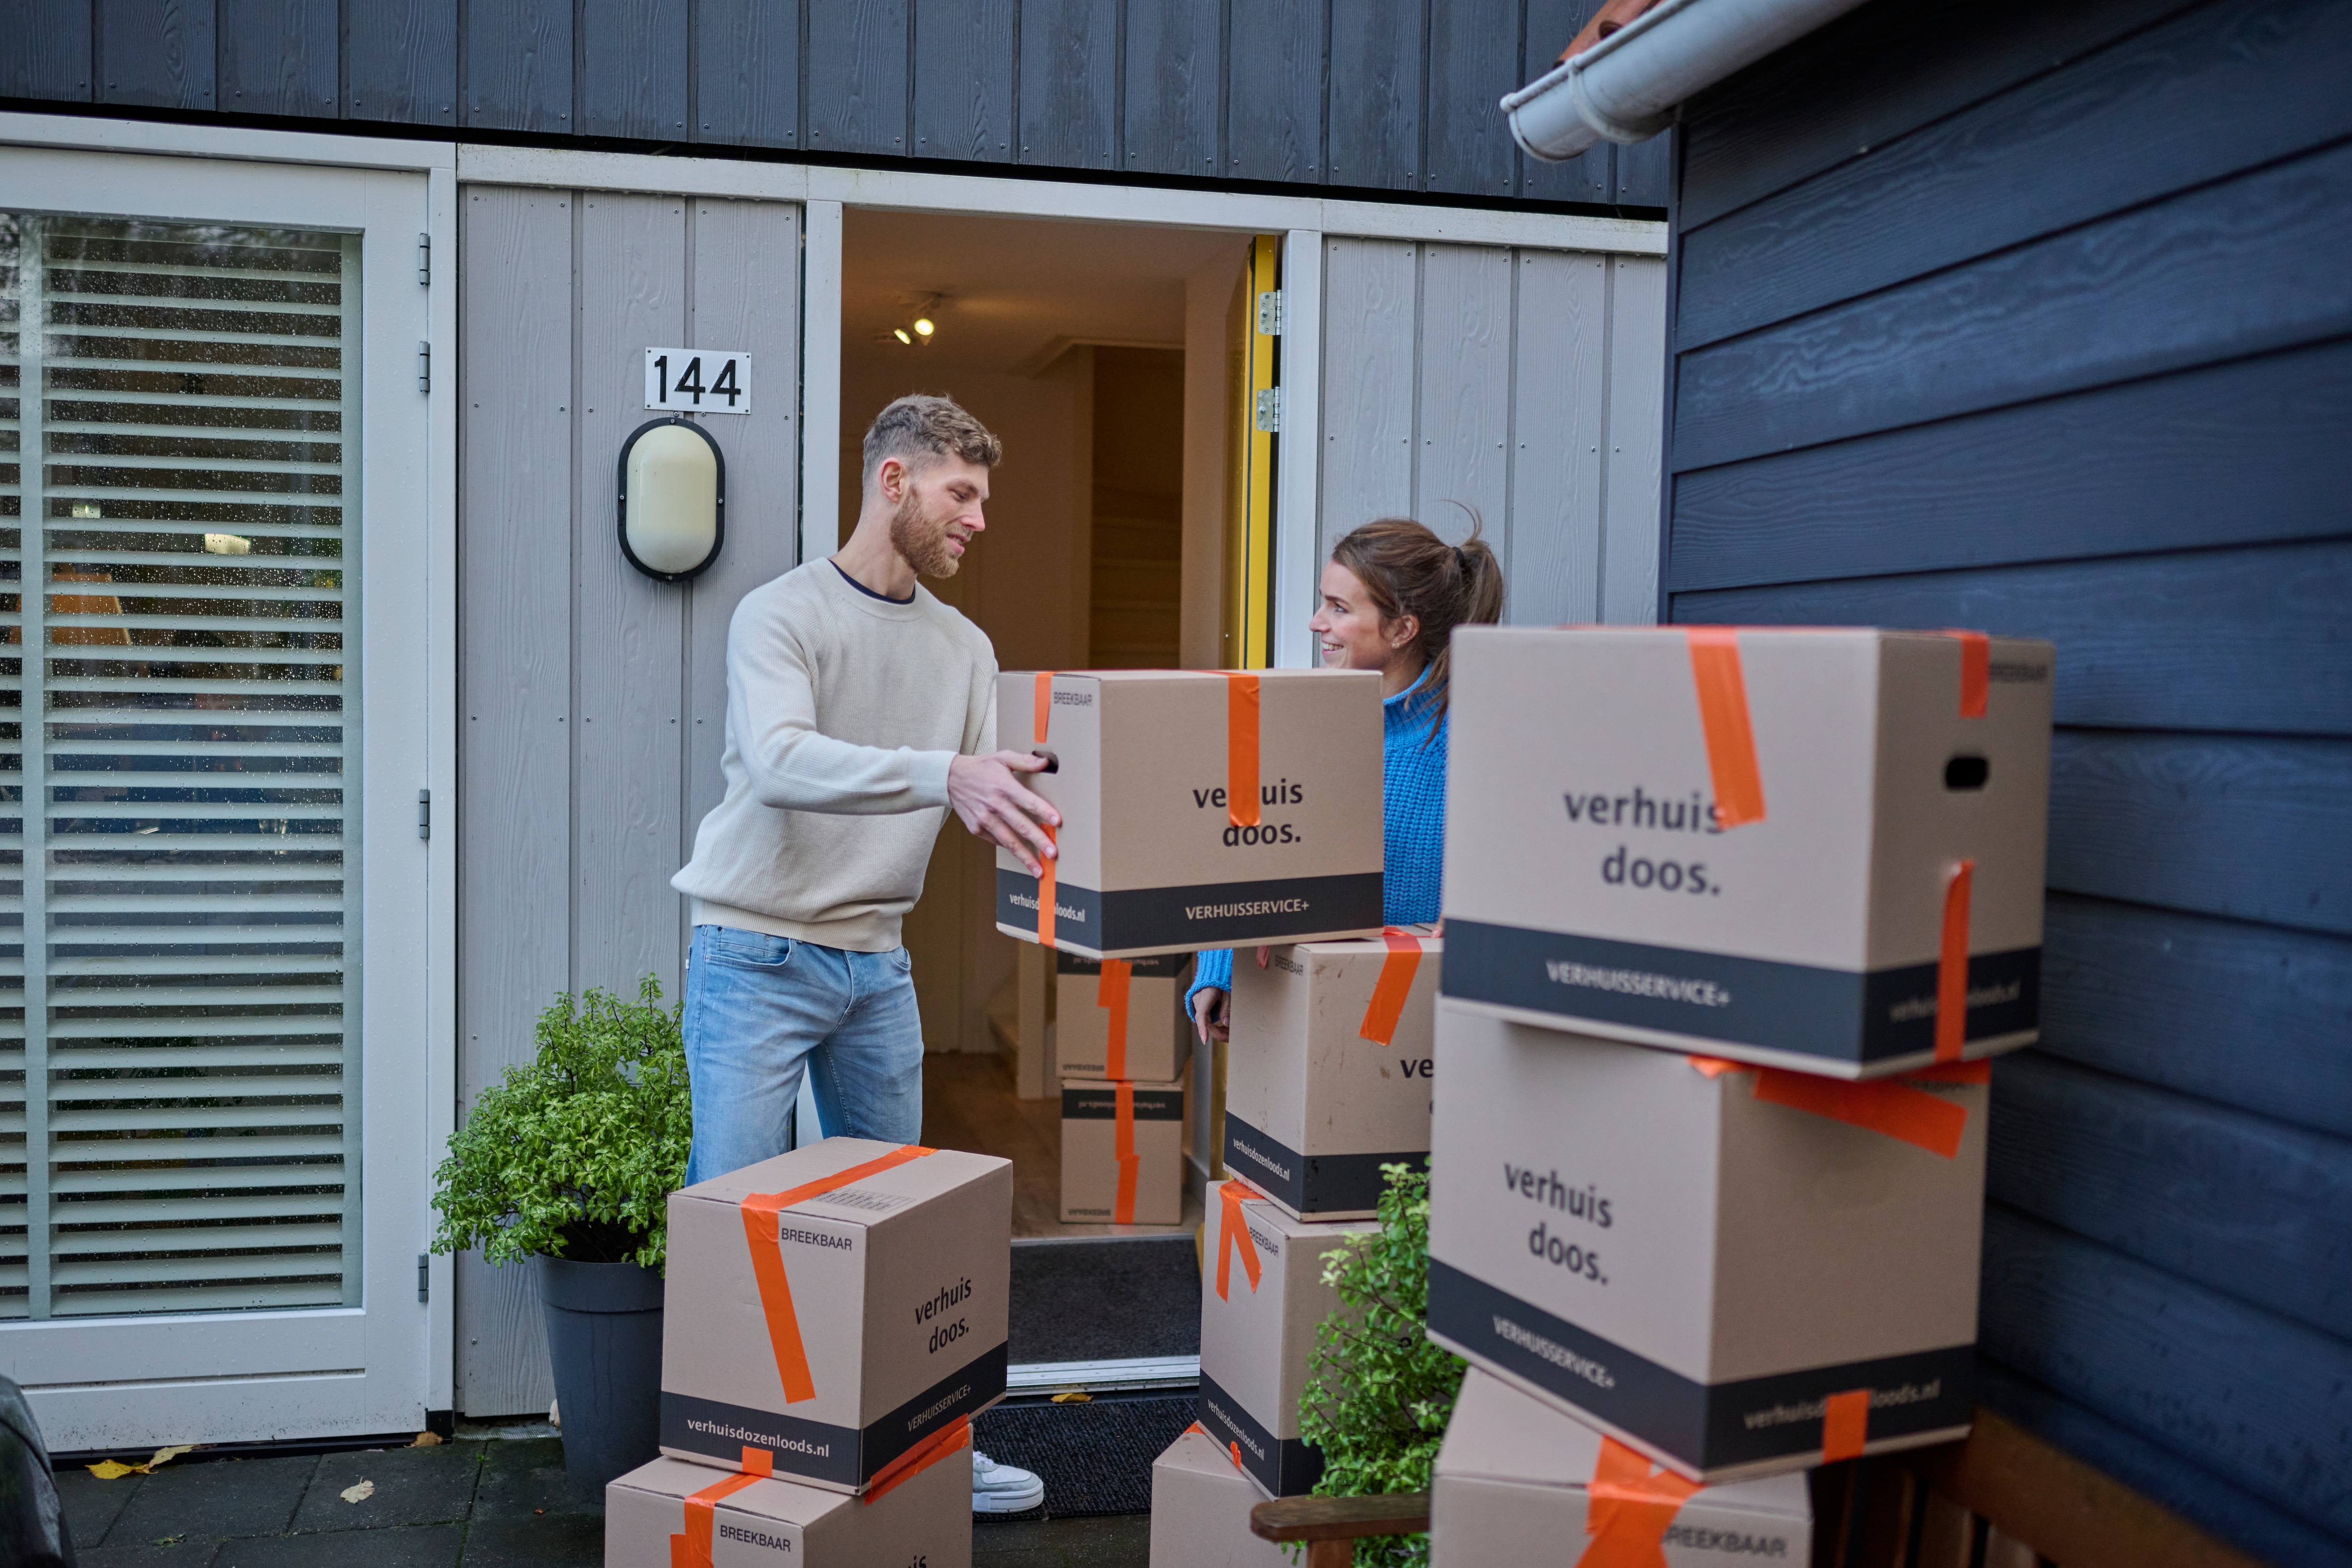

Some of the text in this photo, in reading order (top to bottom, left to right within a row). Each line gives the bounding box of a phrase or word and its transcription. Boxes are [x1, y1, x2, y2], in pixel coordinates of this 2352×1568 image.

[654, 355, 741, 406] 144
[1054, 692, 1092, 707] BREEKBAAR
[1192, 778, 1303, 809] veuis
[1223, 824, 1301, 847] doos.
[1602, 845, 1721, 895] doos.
[1009, 893, 1085, 923] verhuisdloods.nl
[1185, 899, 1309, 920] VERHUISSERVICE+
[1275, 955, 1303, 977] BREEKBAAR
[1233, 1138, 1290, 1182] verhuisdozenloods.nl
[1504, 1164, 1612, 1228] verhuis
[781, 1228, 852, 1251] BREEKBAAR
[1529, 1222, 1608, 1286] doos.
[915, 1277, 971, 1325] verhuis
[929, 1316, 969, 1354] doos.
[908, 1385, 971, 1432] VERHUISSERVICE+
[687, 1419, 829, 1457] verhuisdozenloods.nl
[1208, 1399, 1264, 1461] verhuisdozenloods.nl
[720, 1525, 790, 1552] BREEKBAAR
[1664, 1525, 1787, 1558] REEKBAAR
